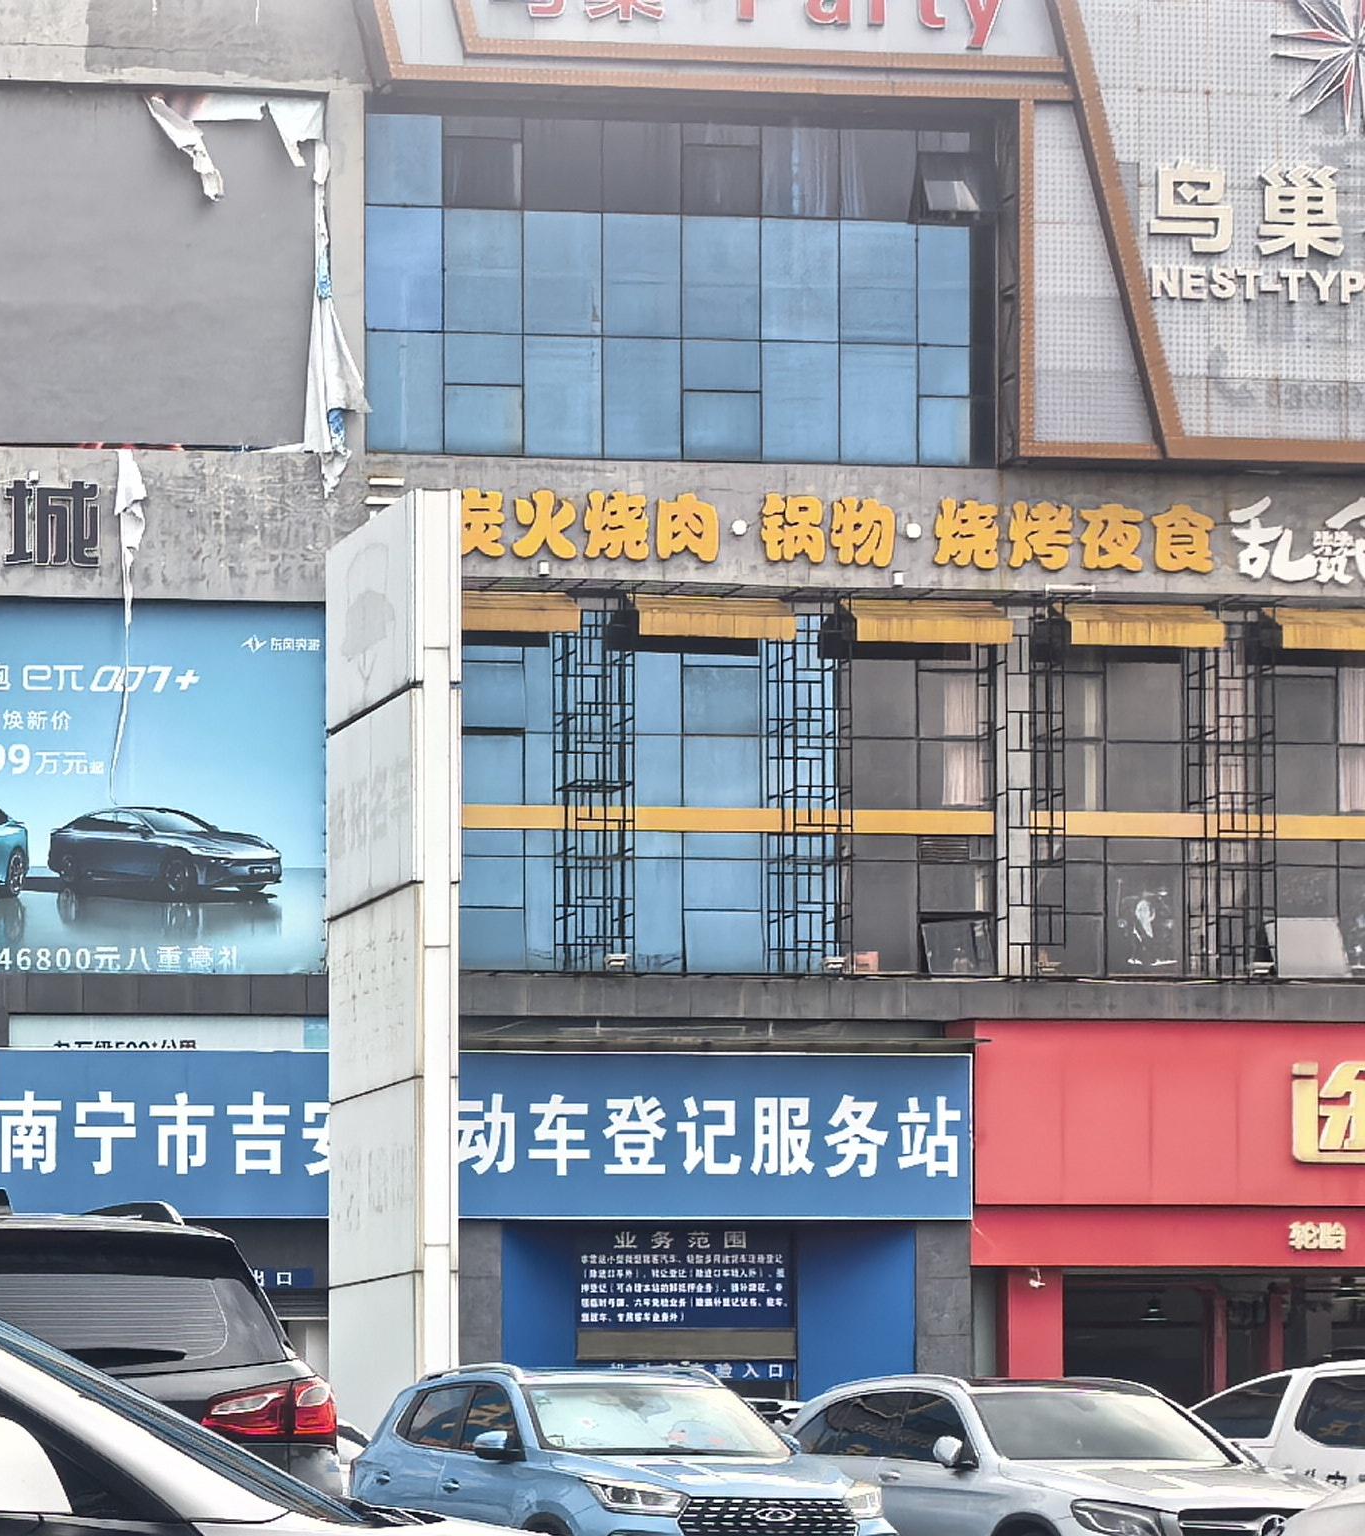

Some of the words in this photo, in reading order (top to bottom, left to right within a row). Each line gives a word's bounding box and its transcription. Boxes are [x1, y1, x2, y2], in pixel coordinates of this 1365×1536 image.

[1149, 159, 1345, 258] 鸟巢
[612, 1230, 747, 1250] 业务范围
[1288, 1221, 1347, 1252] 轮胎
